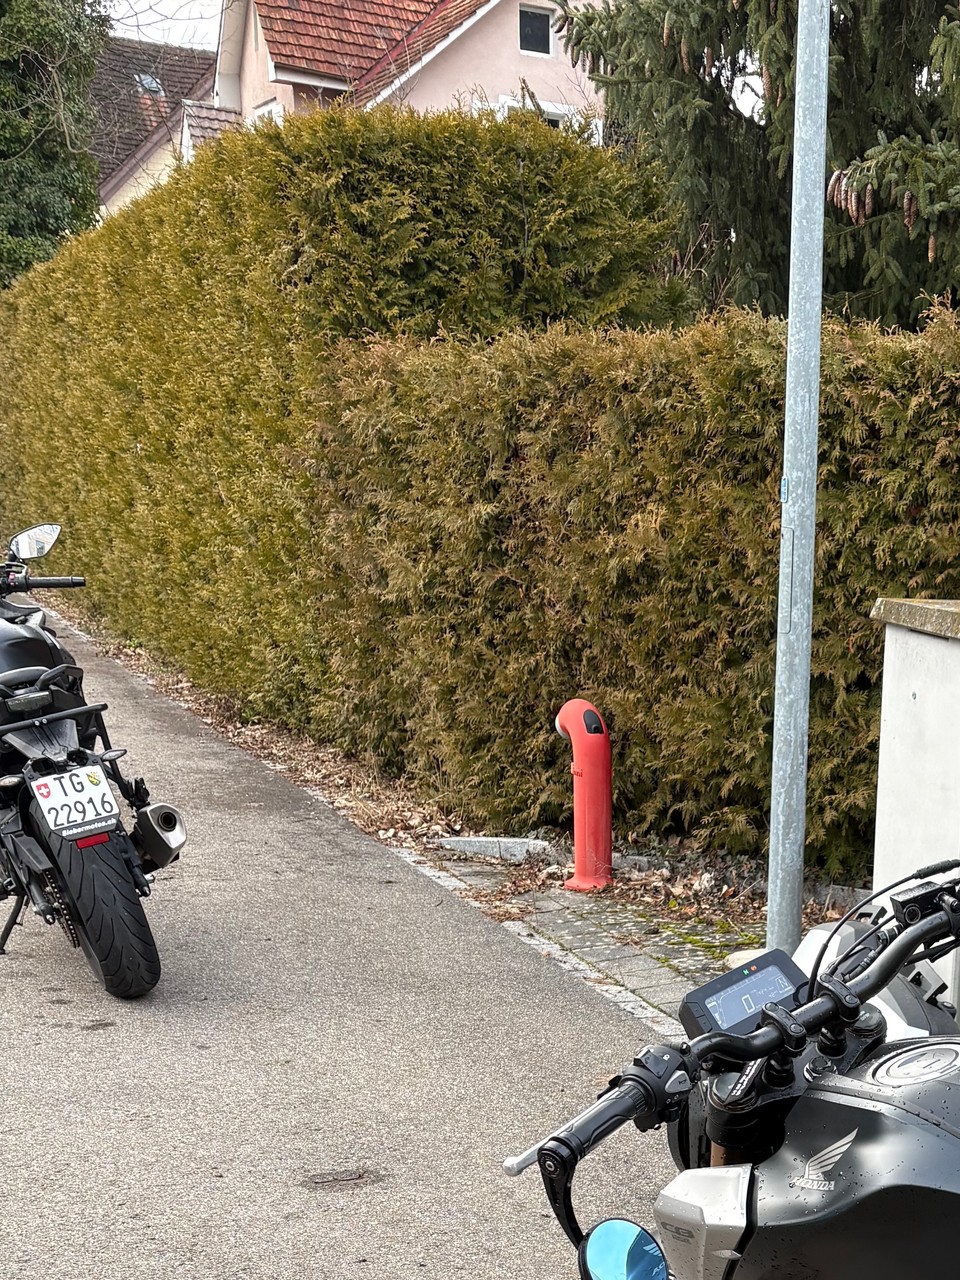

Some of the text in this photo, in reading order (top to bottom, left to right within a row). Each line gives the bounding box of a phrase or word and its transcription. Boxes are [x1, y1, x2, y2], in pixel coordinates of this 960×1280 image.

[53, 772, 85, 797] TG
[47, 793, 114, 828] 22916
[741, 994, 756, 1014] 0
[789, 1176, 836, 1191] HONDA
